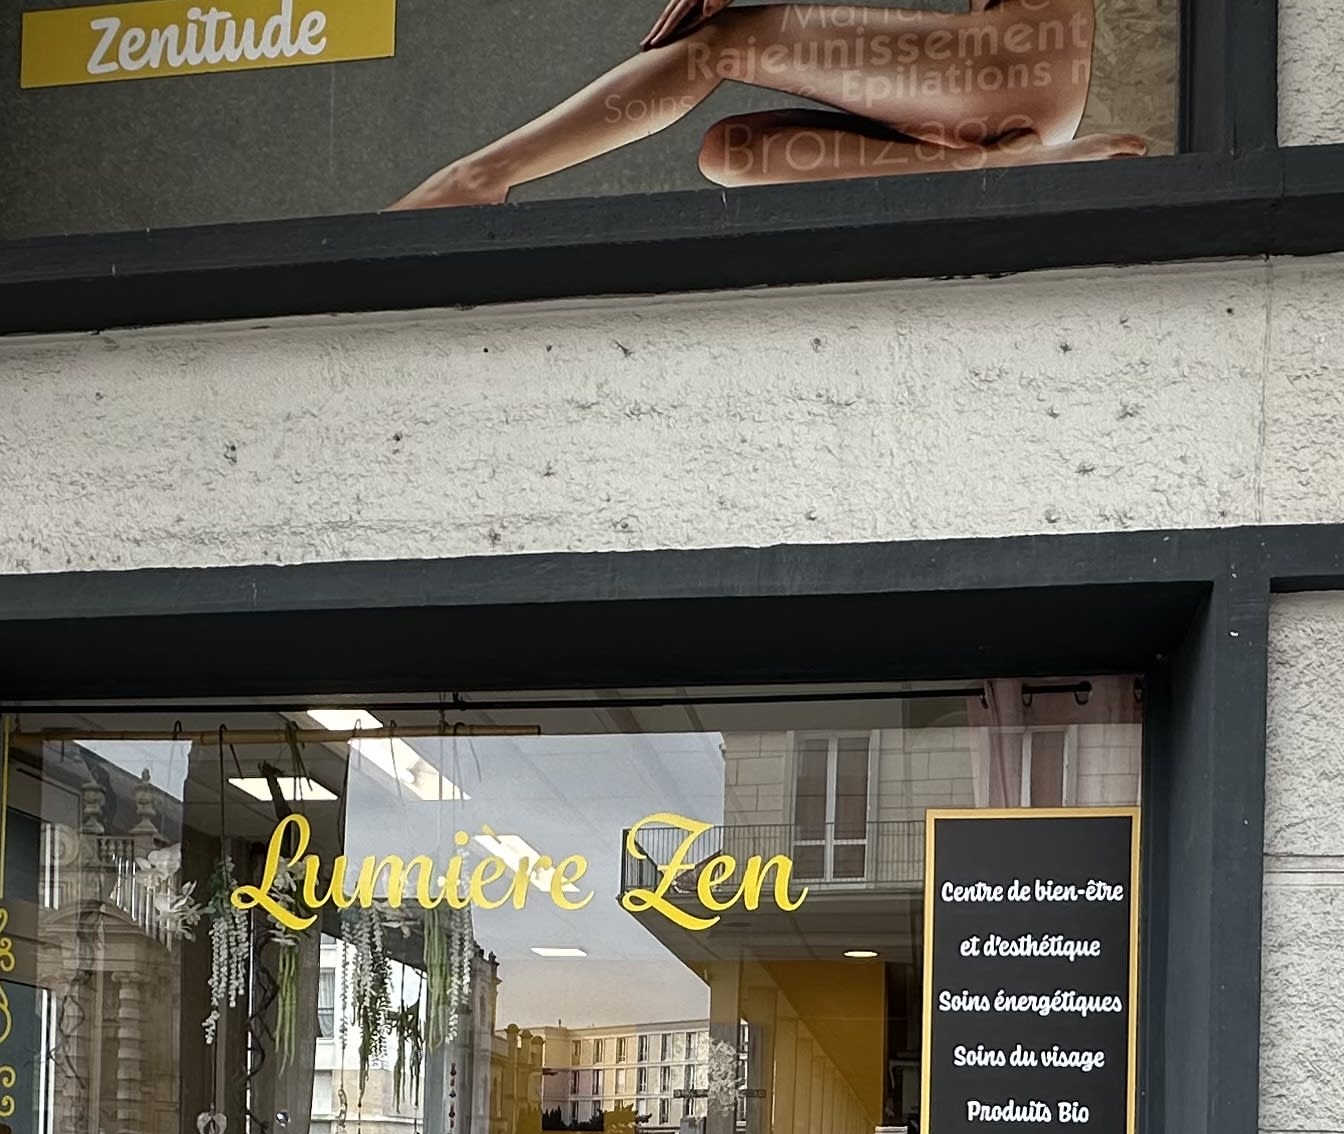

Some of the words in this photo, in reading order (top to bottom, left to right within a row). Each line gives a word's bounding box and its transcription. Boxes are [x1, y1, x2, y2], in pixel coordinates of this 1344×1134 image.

[87, 0, 327, 75] Zenitude
[687, 11, 1091, 84] Rajeunissement
[842, 59, 1052, 107] Epilations
[604, 92, 694, 124] Soins
[724, 113, 1035, 178] Bronzage
[230, 813, 595, 931] Lumière
[621, 812, 810, 931] Zen
[942, 881, 1003, 902] Centre
[1007, 879, 1031, 901] de
[1035, 879, 1124, 901] bien-être
[960, 936, 980, 957] et
[983, 934, 1101, 962] d'esthétique
[939, 990, 990, 1012] Soins
[994, 989, 1122, 1017] énergétiques
[954, 1045, 1006, 1067] Soins
[1010, 1044, 1038, 1067] du
[1041, 1045, 1105, 1072] visage
[967, 1099, 1052, 1123] Produits
[1058, 1101, 1090, 1123] Bio
